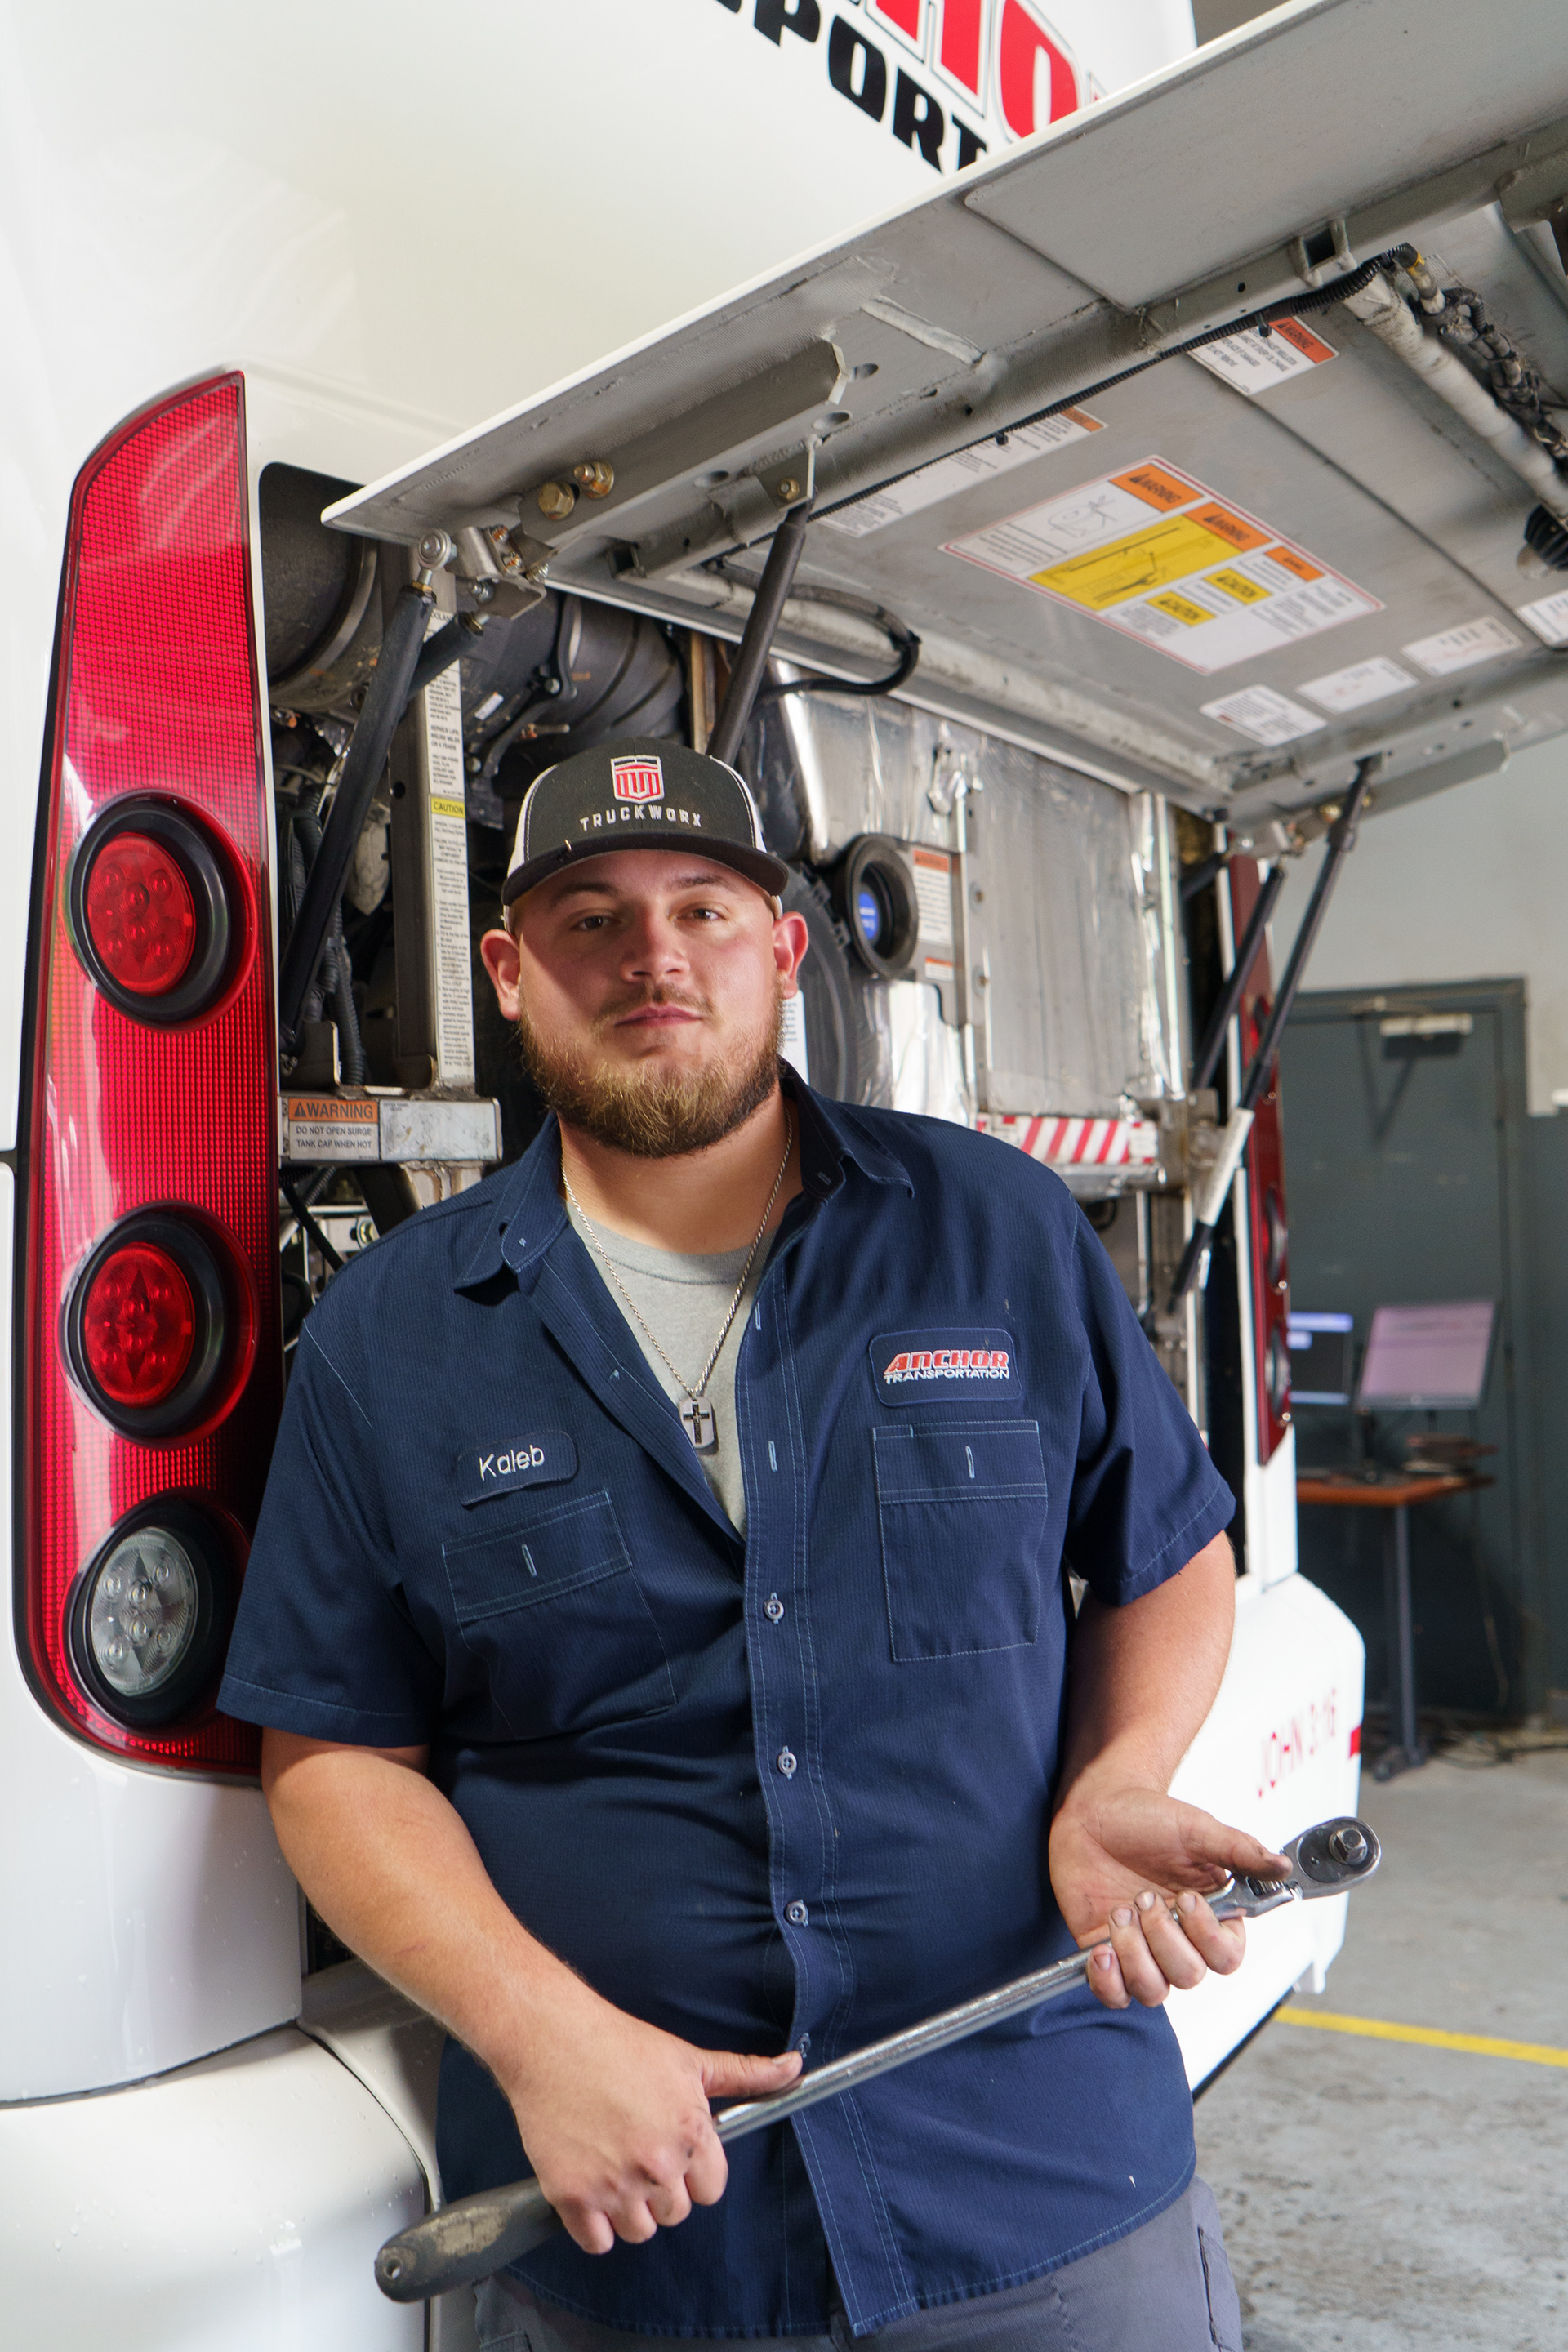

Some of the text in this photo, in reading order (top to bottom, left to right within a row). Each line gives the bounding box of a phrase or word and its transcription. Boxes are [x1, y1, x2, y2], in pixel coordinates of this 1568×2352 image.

[712, 0, 987, 175] PORT
[1141, 477, 1182, 504] WARNING
[1211, 518, 1250, 542] WARNING
[433, 801, 464, 815] CAUTION
[580, 804, 702, 831] TRUCKWORX
[306, 1102, 373, 1118] WARNING
[296, 1125, 372, 1136] DO NOT OPEN SURGE
[296, 1139, 372, 1148] TANK CAP WHEN HOT
[884, 1349, 1009, 1374] ANCHOR
[884, 1368, 1009, 1384] TRANSPORTATION
[479, 1444, 545, 1481] Kaleb
